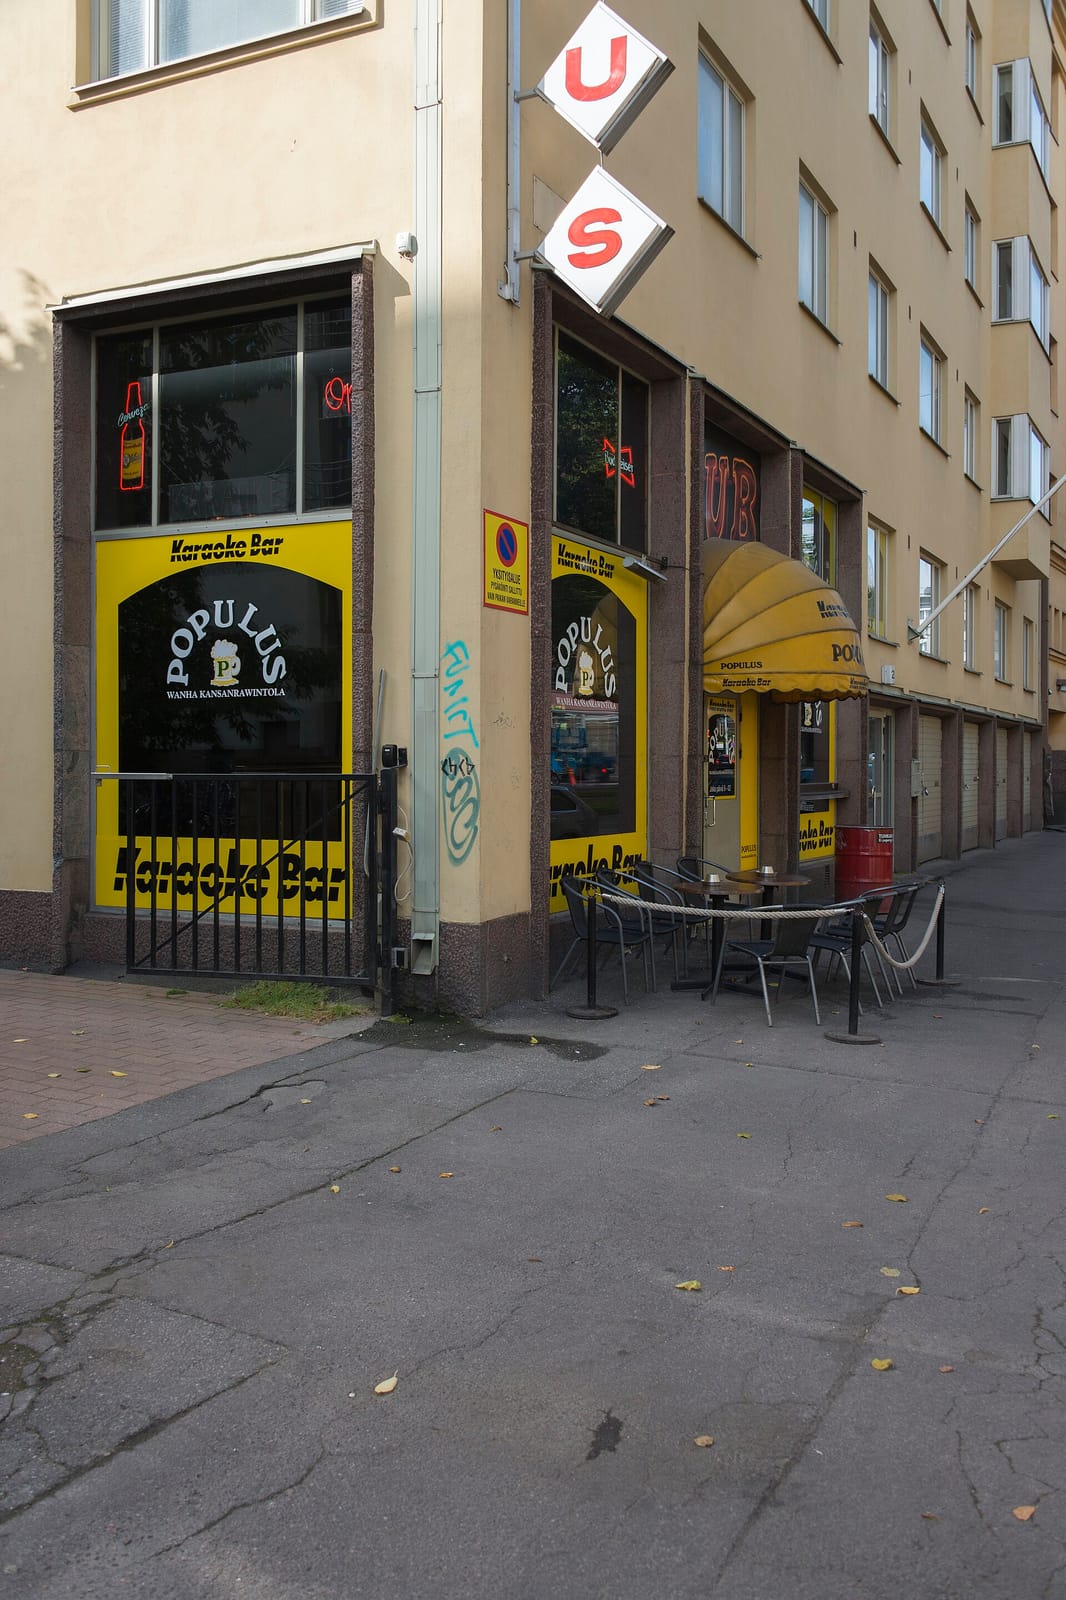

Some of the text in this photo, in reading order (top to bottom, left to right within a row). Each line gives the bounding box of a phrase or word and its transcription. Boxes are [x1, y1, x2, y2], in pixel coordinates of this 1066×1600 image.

[604, 449, 634, 473] Budeiser
[170, 532, 284, 562] Karaoke Bar
[557, 542, 615, 579] Karaoke Bar
[166, 599, 287, 686] POPULUS
[217, 660, 230, 677] P
[555, 616, 617, 698] POPULUS
[720, 661, 763, 670] POPULUS
[166, 687, 286, 699] WANHA KANSANRAWINTOLA
[722, 677, 772, 687] Karaoke Bar
[112, 846, 346, 902] Karaoke Bar
